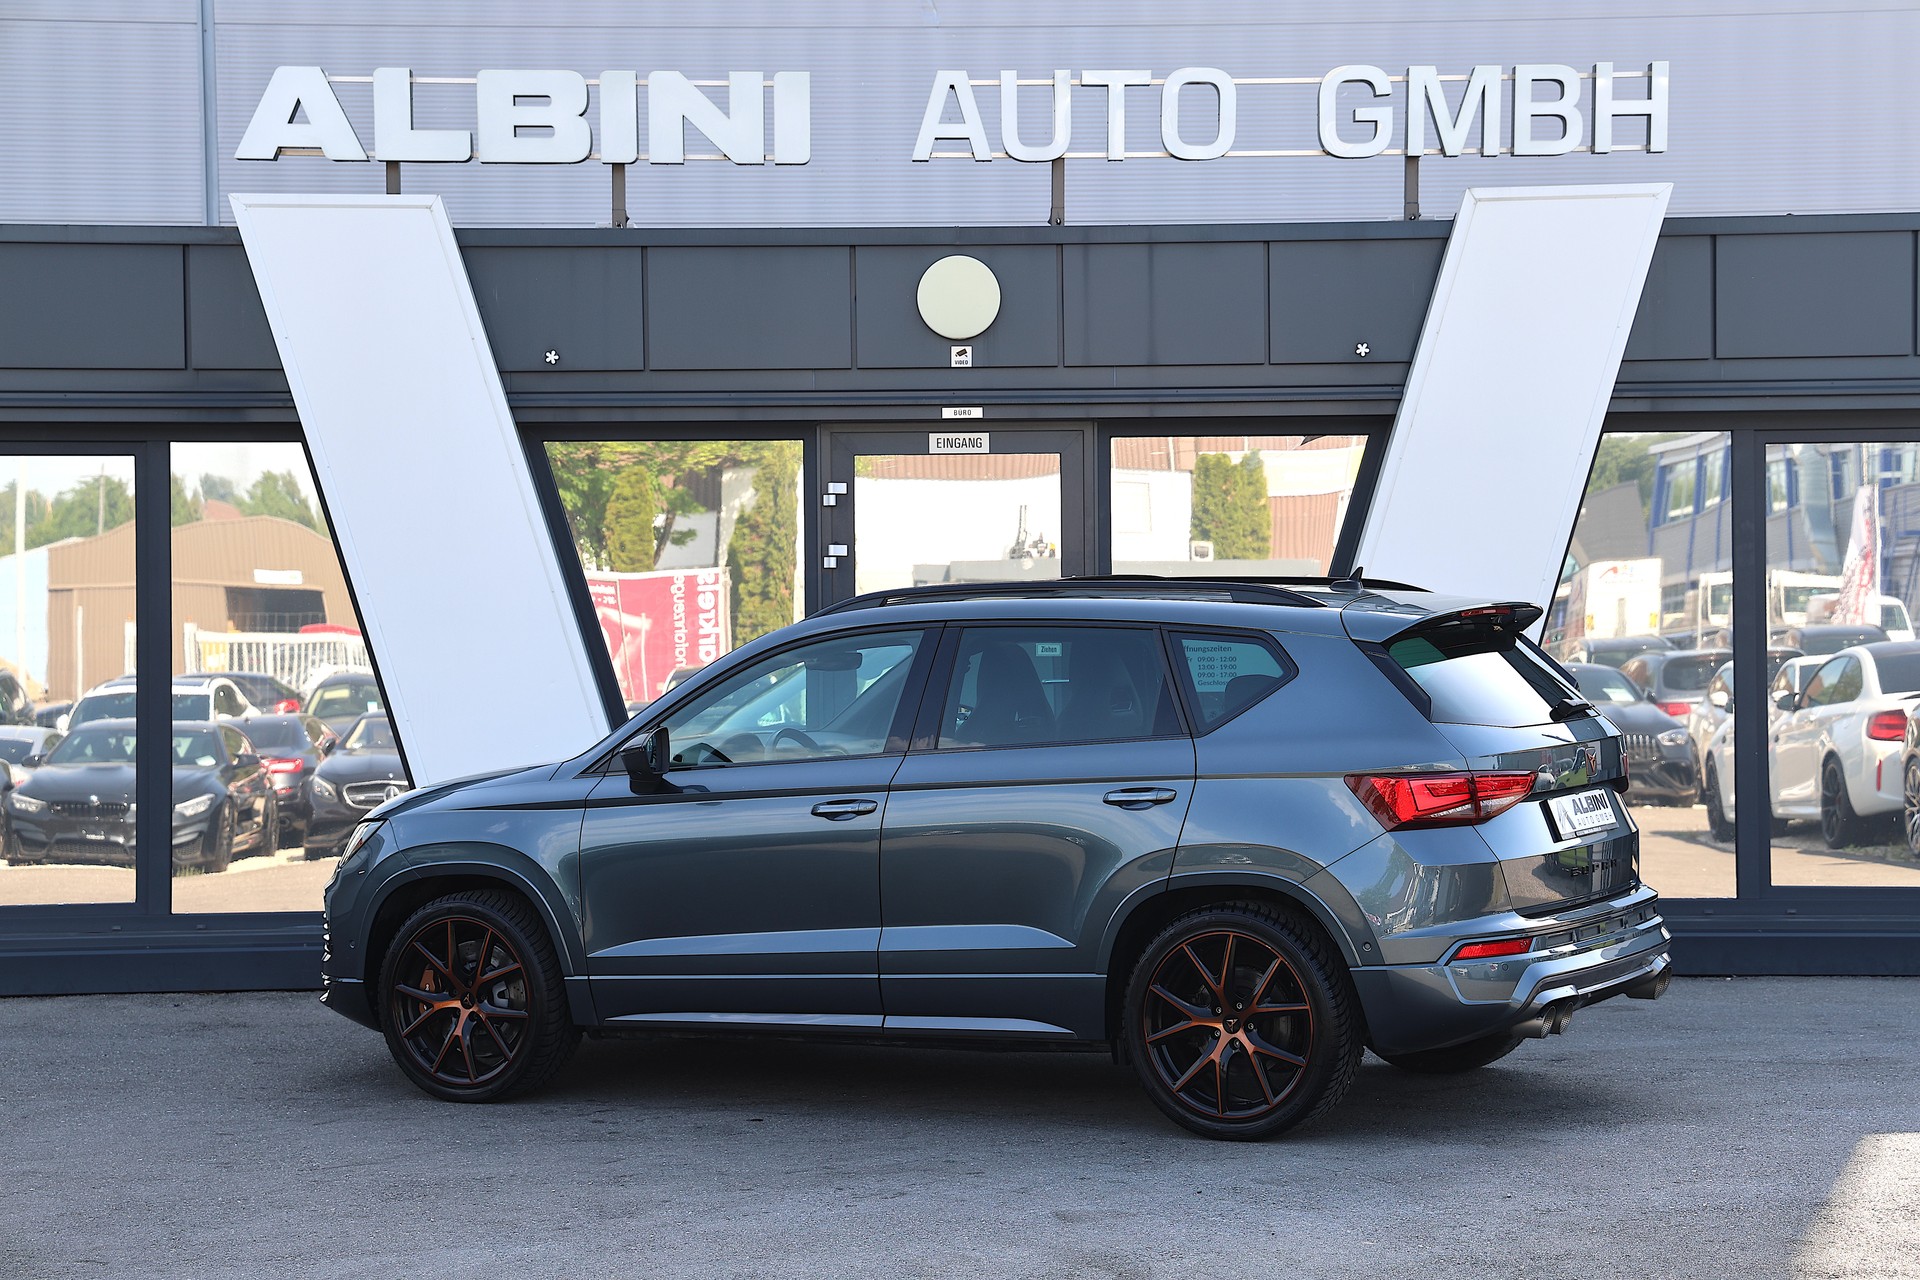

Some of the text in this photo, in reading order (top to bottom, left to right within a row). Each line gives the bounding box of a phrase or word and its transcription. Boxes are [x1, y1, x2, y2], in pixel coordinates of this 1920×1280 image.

[234, 60, 1670, 165] ALBINI AUTO GMBH
[936, 437, 983, 449] EINGANG
[1572, 793, 1609, 815] ALBINI
[1577, 815, 1595, 827] AUTO
